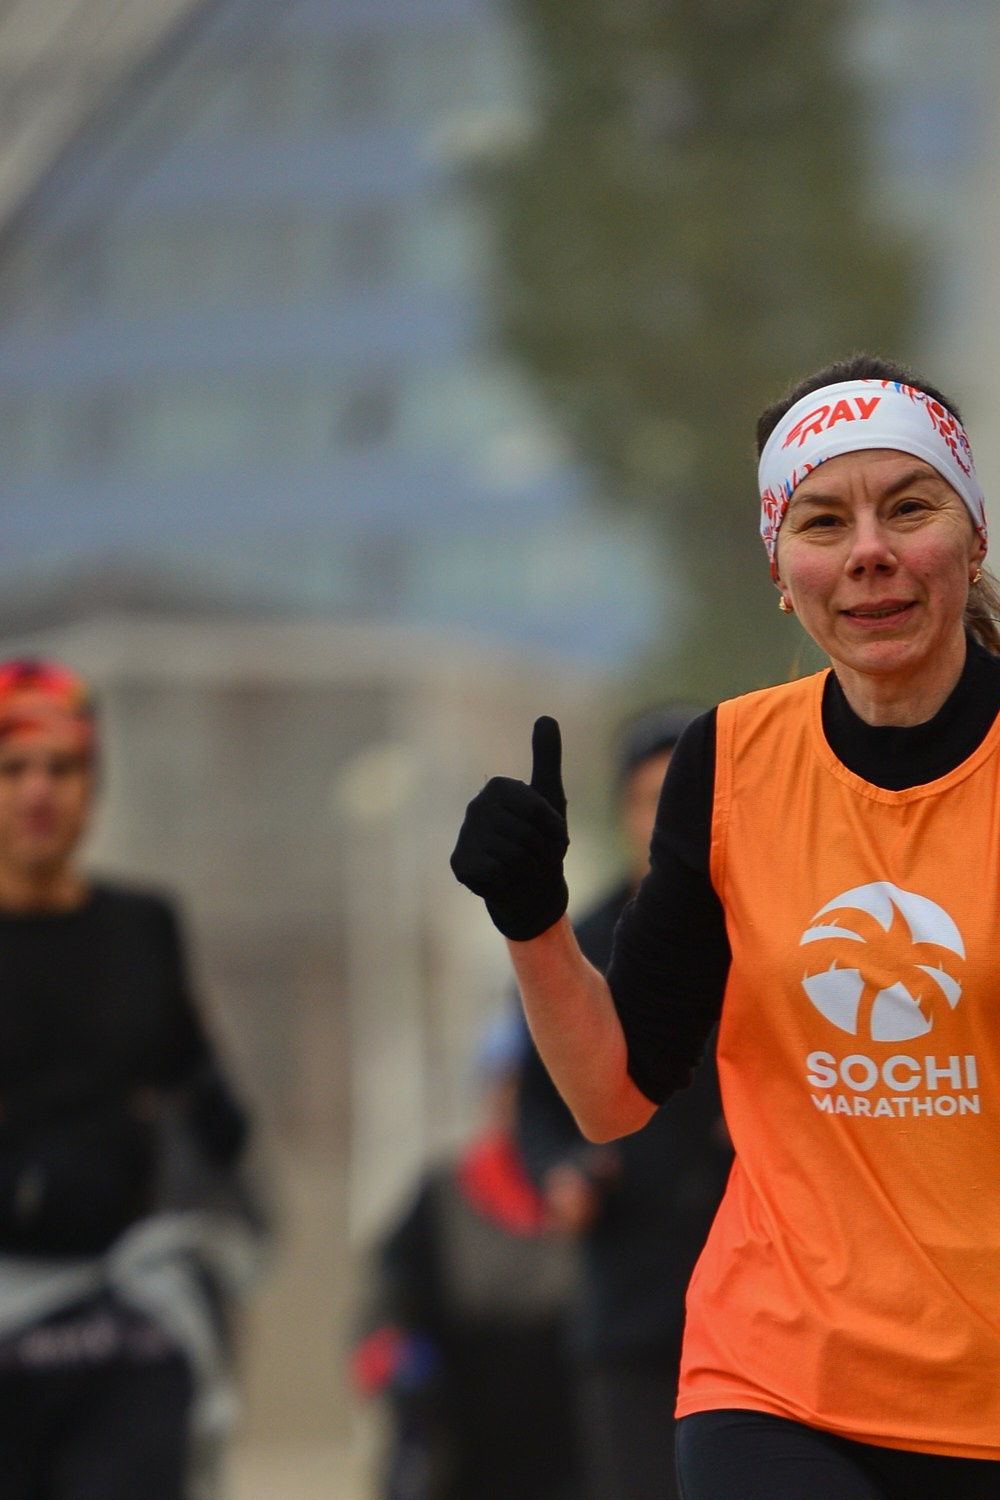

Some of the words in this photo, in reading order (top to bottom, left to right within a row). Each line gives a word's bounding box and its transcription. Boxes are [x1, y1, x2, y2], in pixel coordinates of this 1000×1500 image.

[782, 397, 881, 448] RAY
[806, 1051, 978, 1091] SOCHI
[811, 1094, 980, 1117] MARATHON
